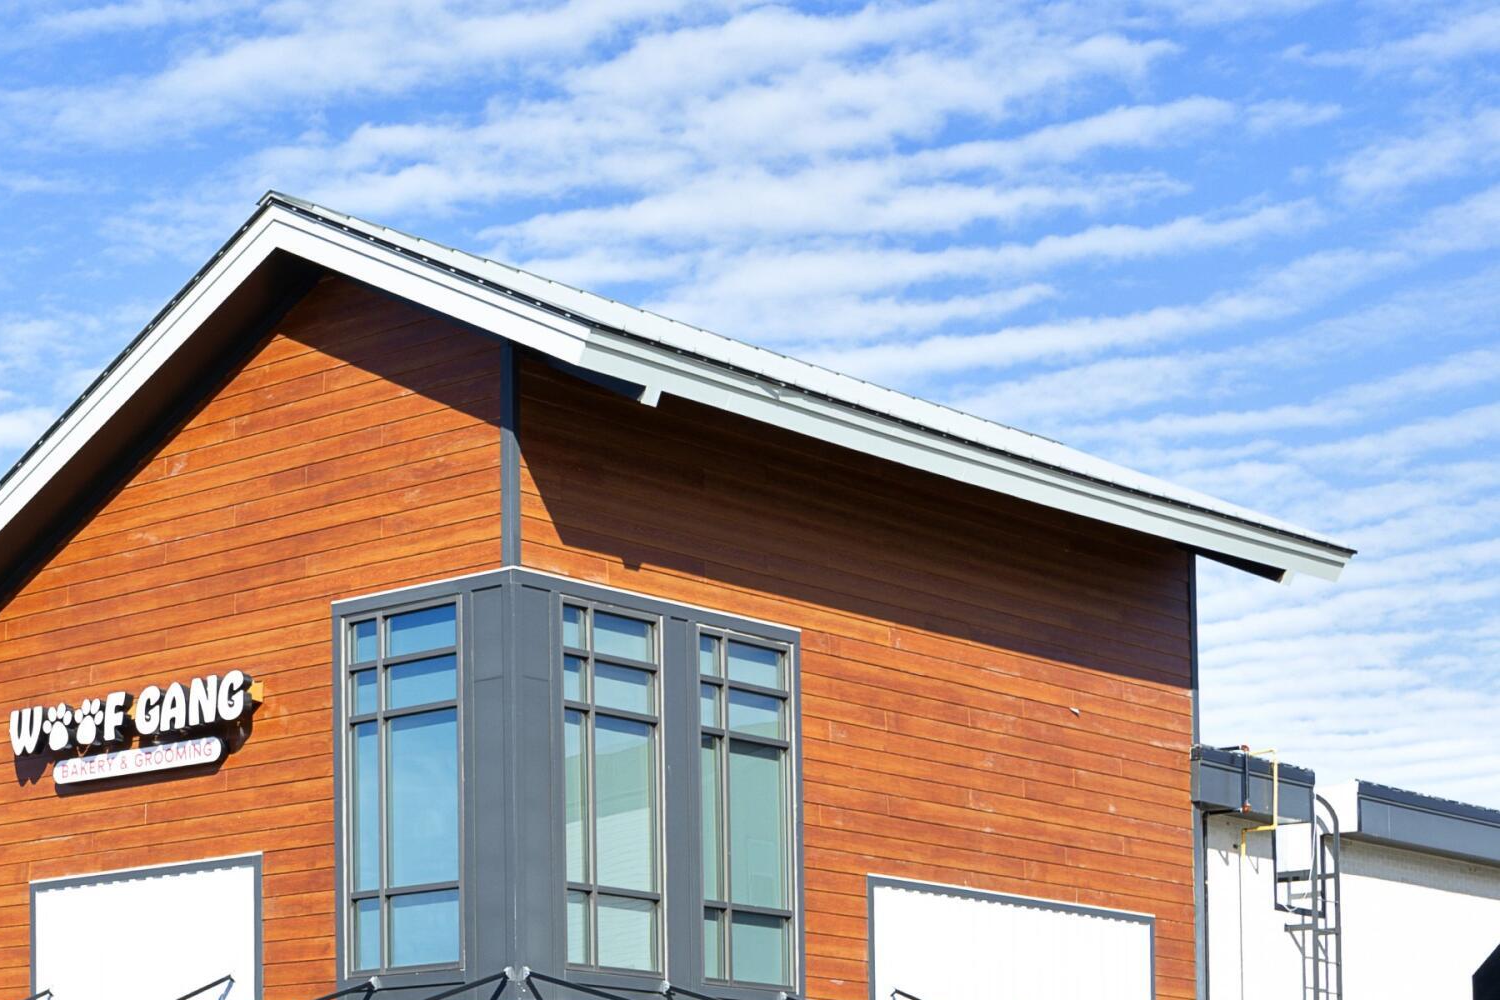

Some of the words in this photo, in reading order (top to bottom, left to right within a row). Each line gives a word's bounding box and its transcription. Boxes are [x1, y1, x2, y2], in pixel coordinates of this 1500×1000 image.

[135, 670, 244, 735] GANG
[61, 757, 116, 779] BAKERY
[119, 757, 129, 769] &
[134, 742, 213, 768] GROOMING
